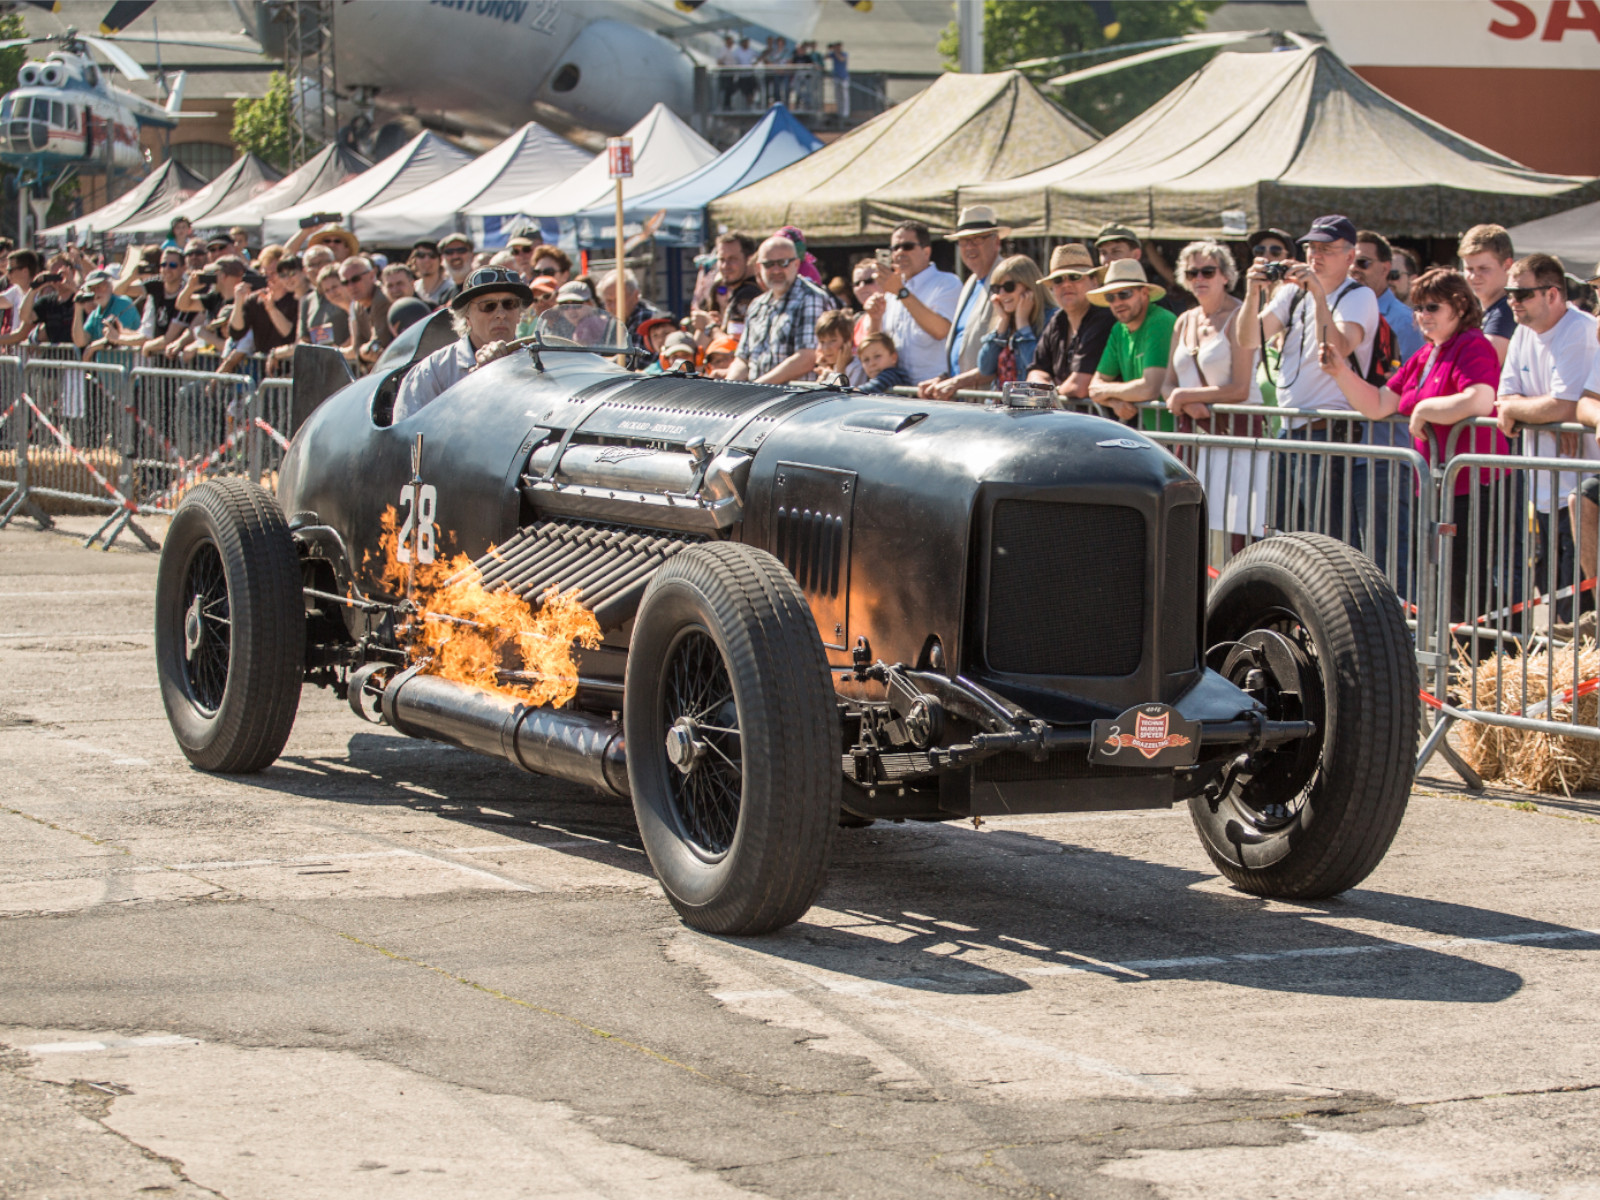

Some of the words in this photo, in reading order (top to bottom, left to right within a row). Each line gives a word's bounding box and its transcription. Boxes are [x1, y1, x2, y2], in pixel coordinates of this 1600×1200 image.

[430, 0, 528, 23] ONOV
[397, 484, 437, 564] 28
[1100, 725, 1121, 755] 3
